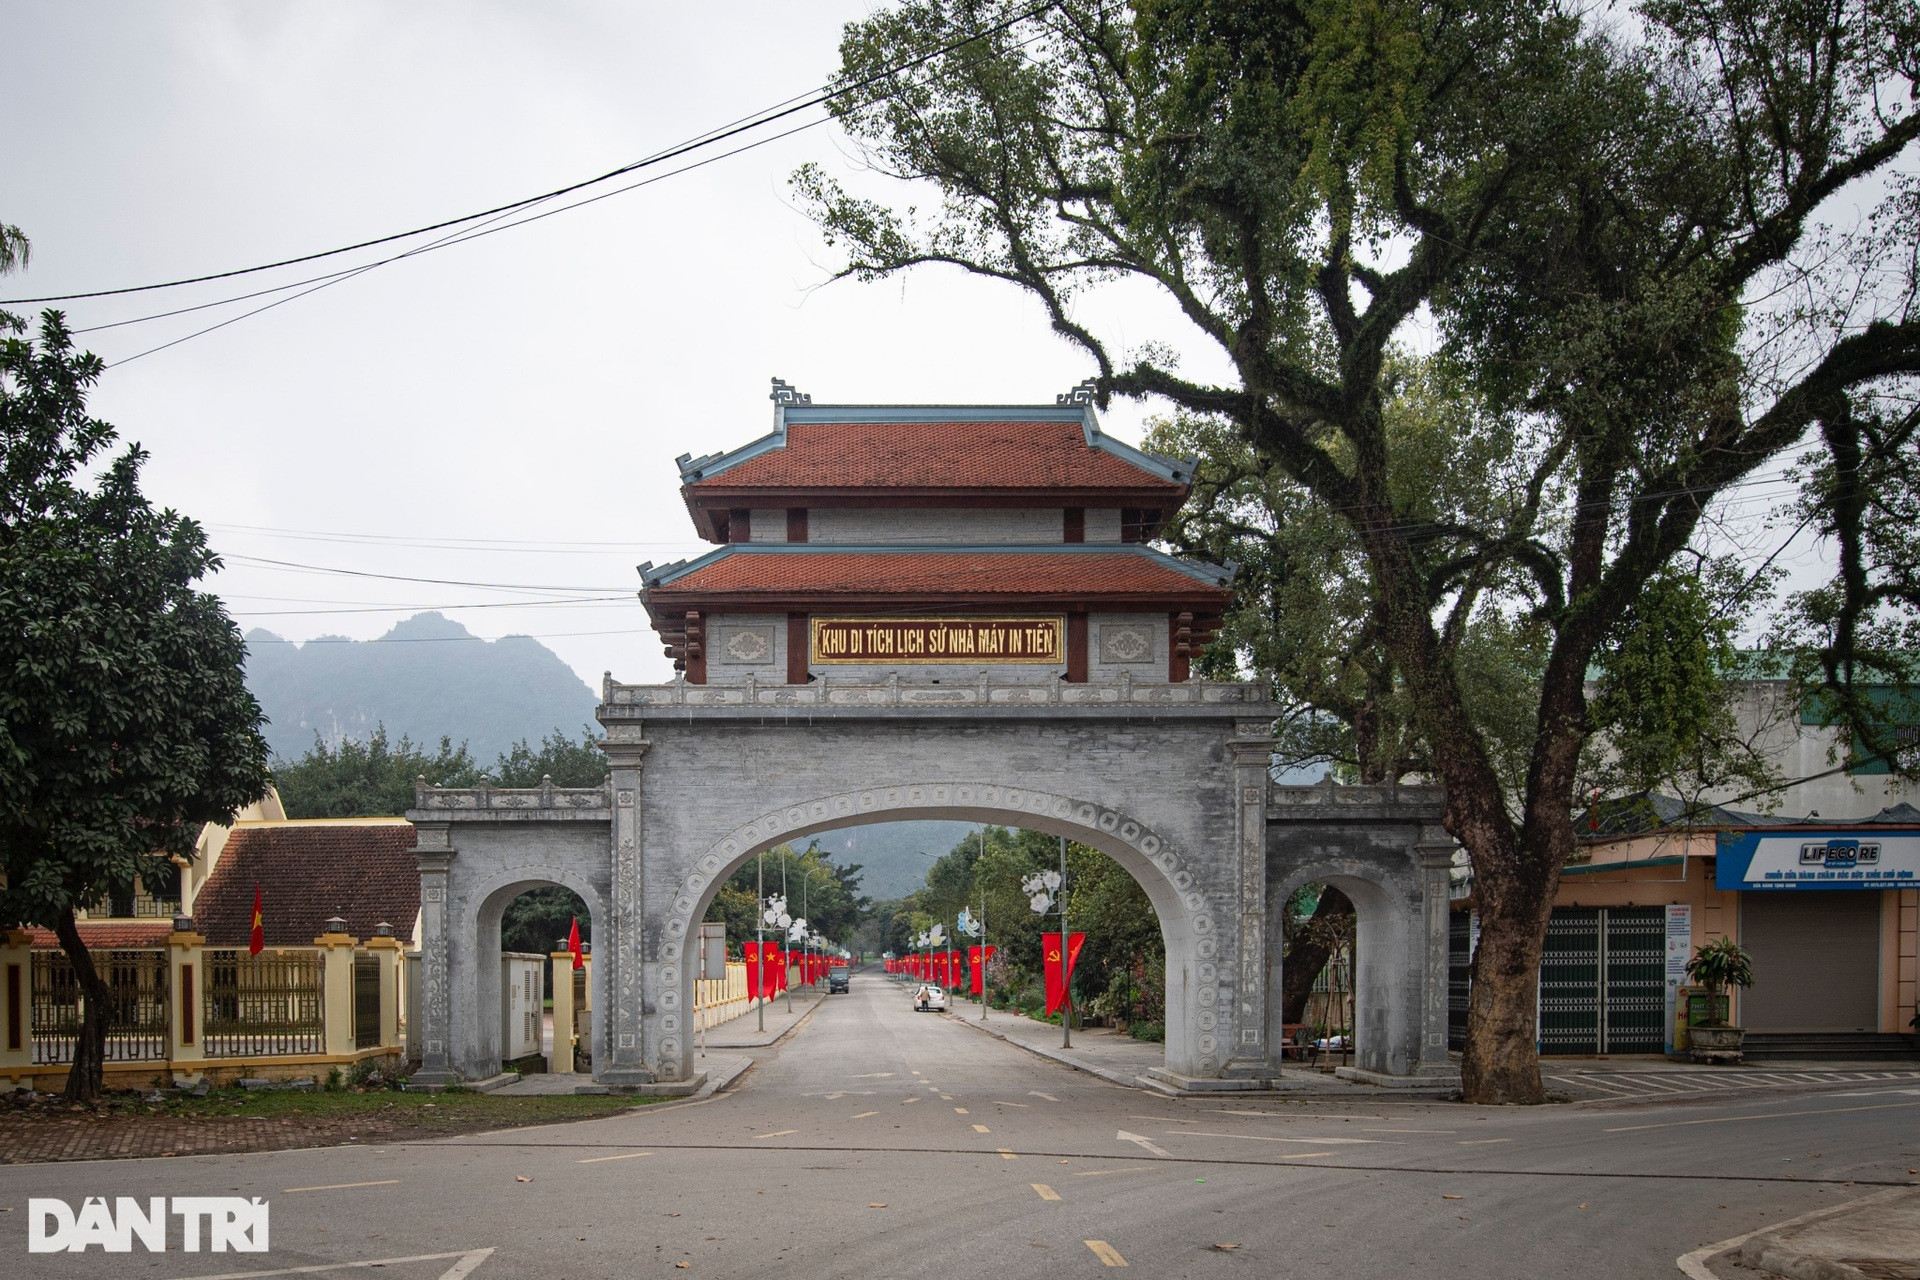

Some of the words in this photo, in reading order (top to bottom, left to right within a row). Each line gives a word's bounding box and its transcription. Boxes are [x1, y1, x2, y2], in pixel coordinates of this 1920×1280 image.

[822, 629, 847, 654] KHU
[850, 629, 863, 654] DI
[866, 624, 893, 654] TÍCH
[897, 629, 925, 657] LỊCH
[929, 623, 947, 654] SỬ
[949, 624, 975, 654] NHÀ
[978, 624, 1006, 654] MÁY
[1009, 629, 1022, 654] IN
[1025, 623, 1053, 654] TIỀN
[1803, 847, 1878, 860] LIFECORE
[1798, 870, 1816, 879] HÀNG
[1837, 870, 1850, 879] SÓC
